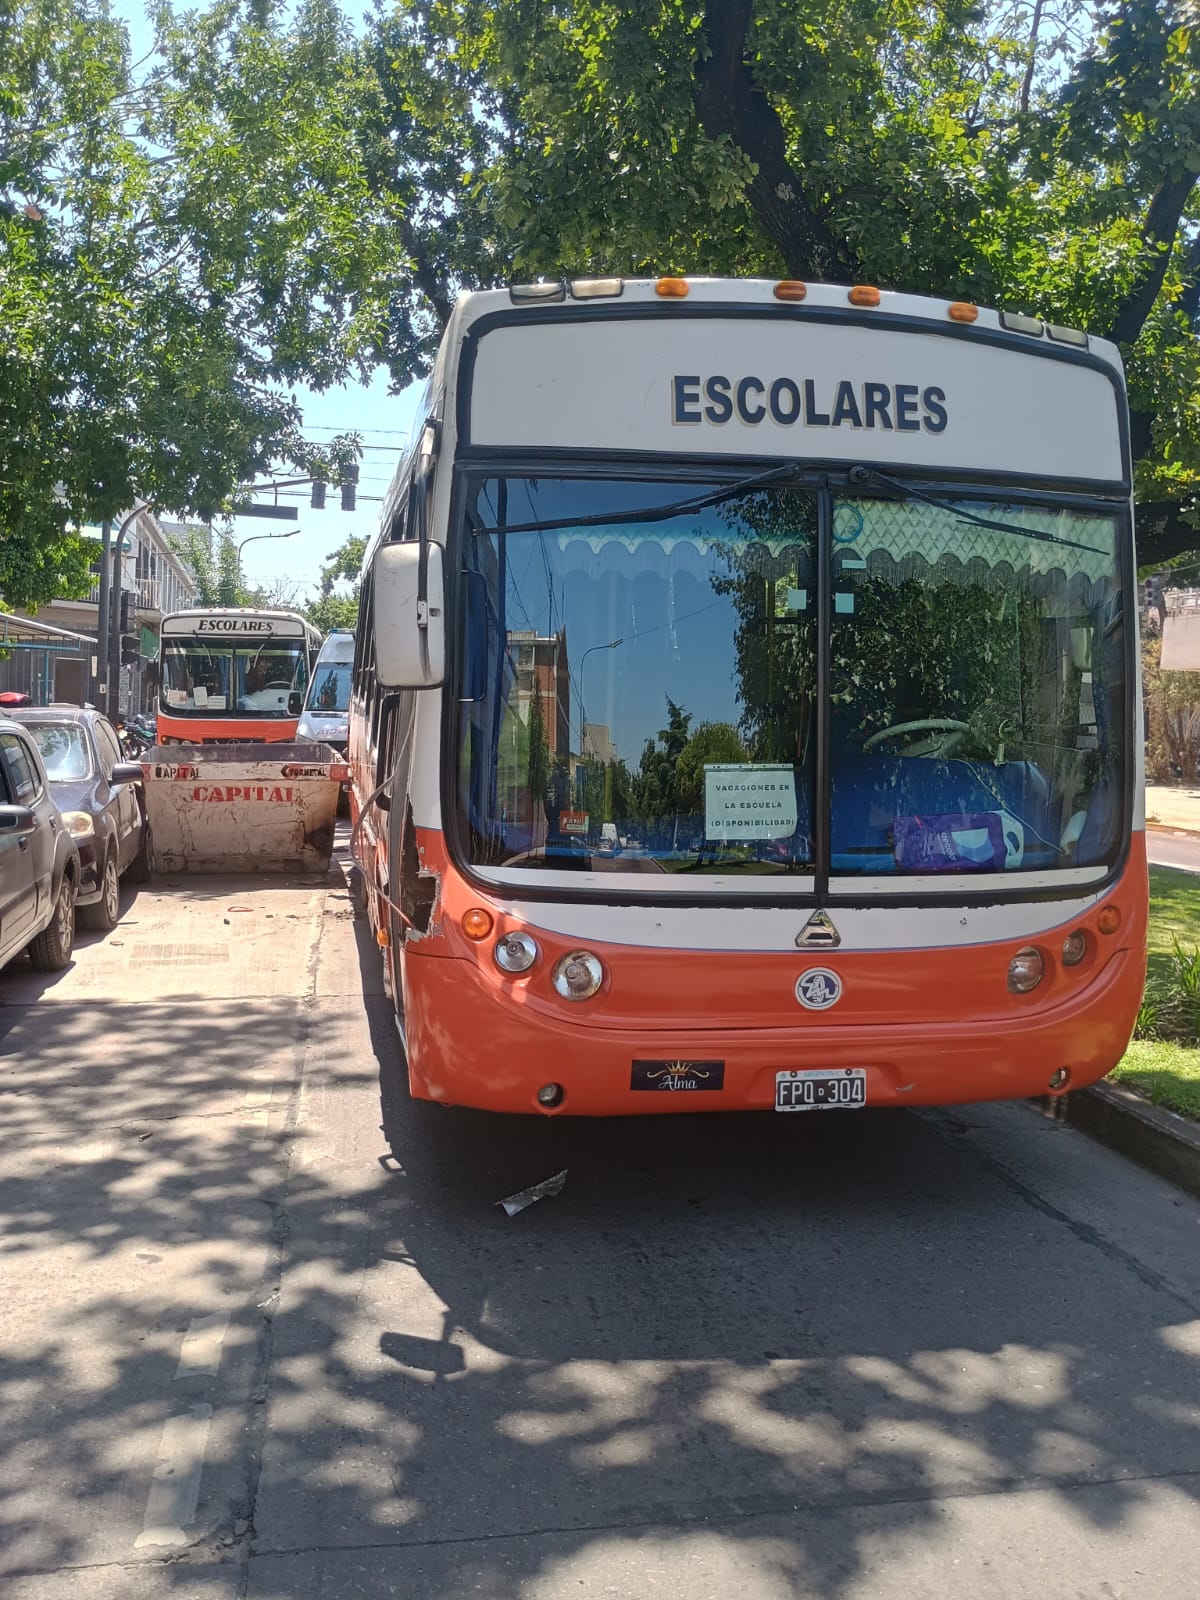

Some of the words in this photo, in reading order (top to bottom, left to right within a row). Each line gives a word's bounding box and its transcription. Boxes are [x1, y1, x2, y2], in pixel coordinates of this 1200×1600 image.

[671, 375, 948, 435] ESCOLARES
[199, 619, 274, 632] ESCOLARES
[658, 1074, 698, 1091] Alma
[779, 1081, 815, 1105] FPQ
[827, 1079, 863, 1103] 304
